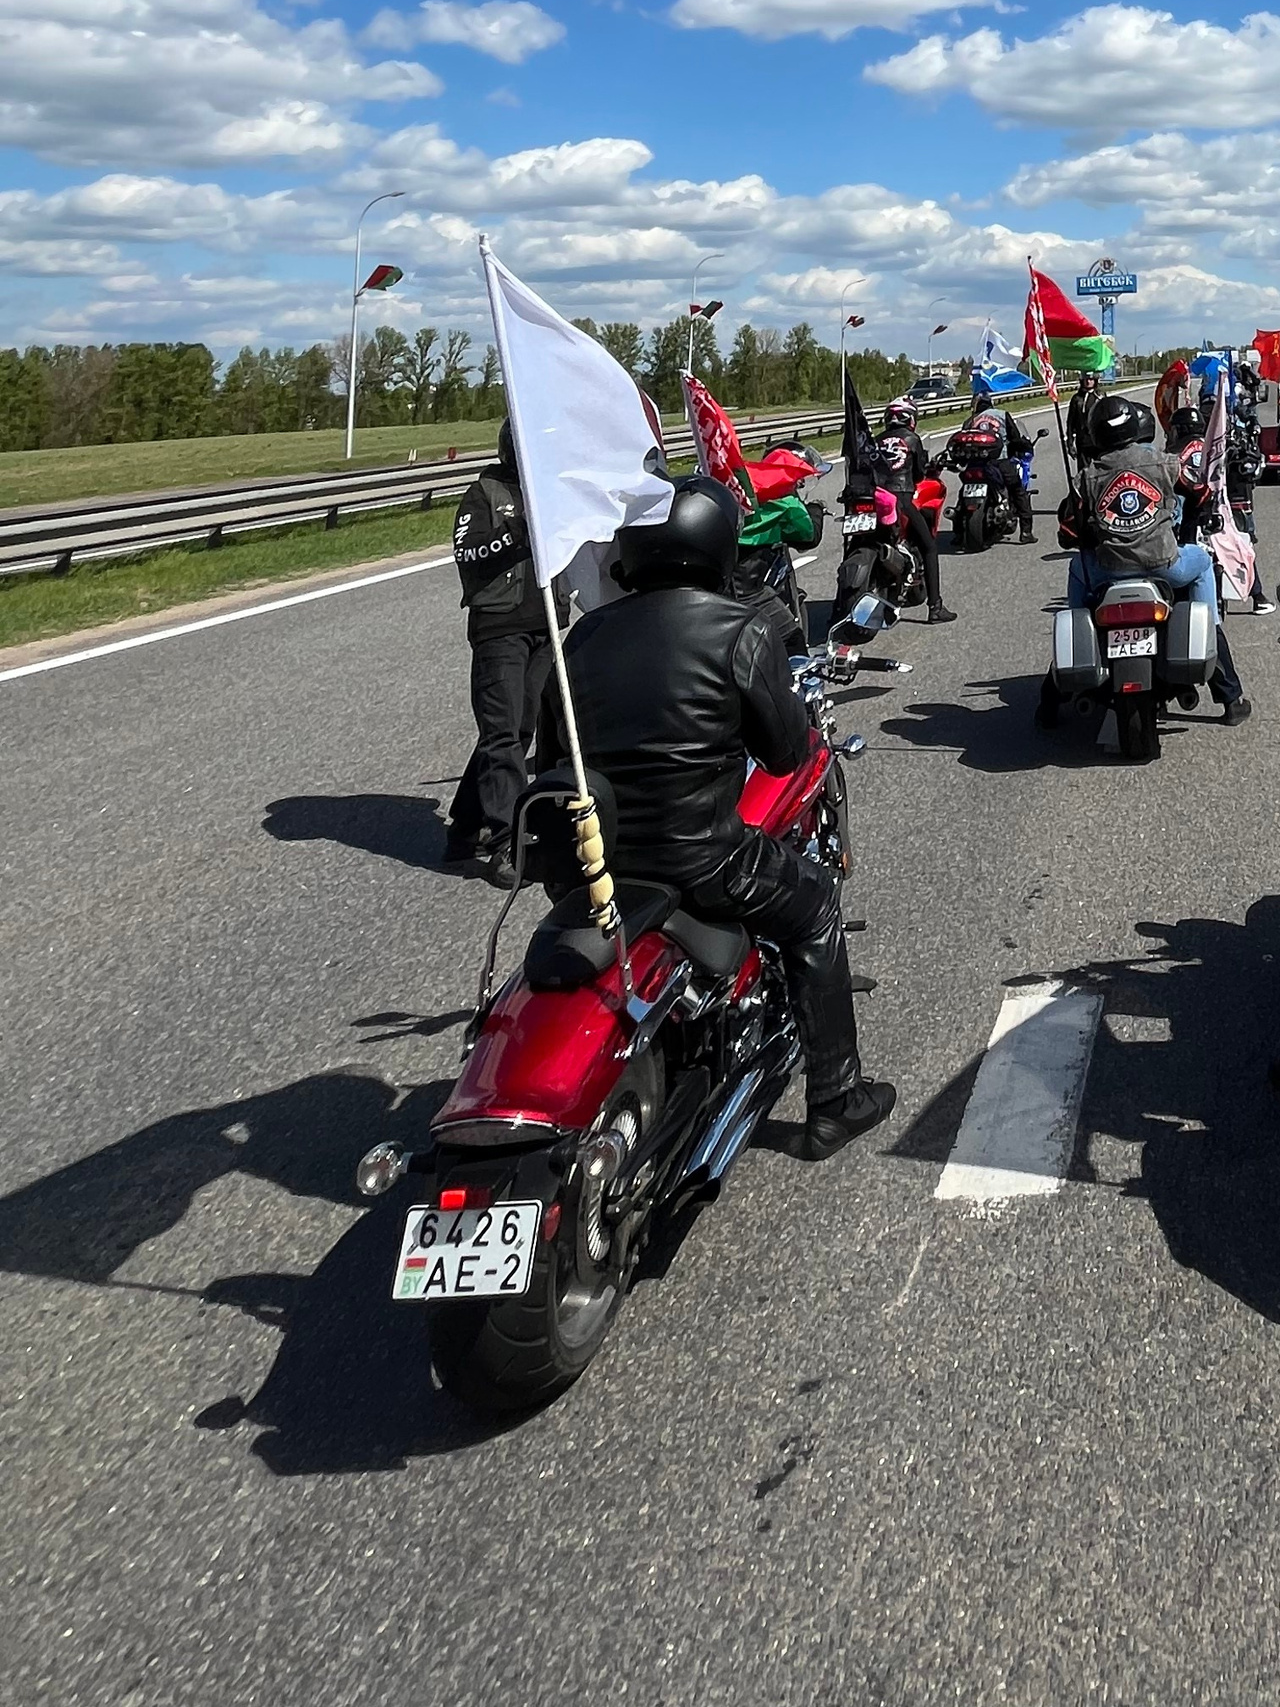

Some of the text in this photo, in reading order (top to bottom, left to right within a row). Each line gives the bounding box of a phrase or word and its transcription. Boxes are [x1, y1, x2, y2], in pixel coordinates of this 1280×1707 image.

[1104, 479, 1155, 503] BOOMERANG
[1114, 512, 1150, 527] BELARUS
[1114, 628, 1150, 643] 2508
[1119, 641, 1152, 656] AE-2
[419, 1210, 521, 1249] 6426
[401, 1253, 521, 1294] BY AE-2
